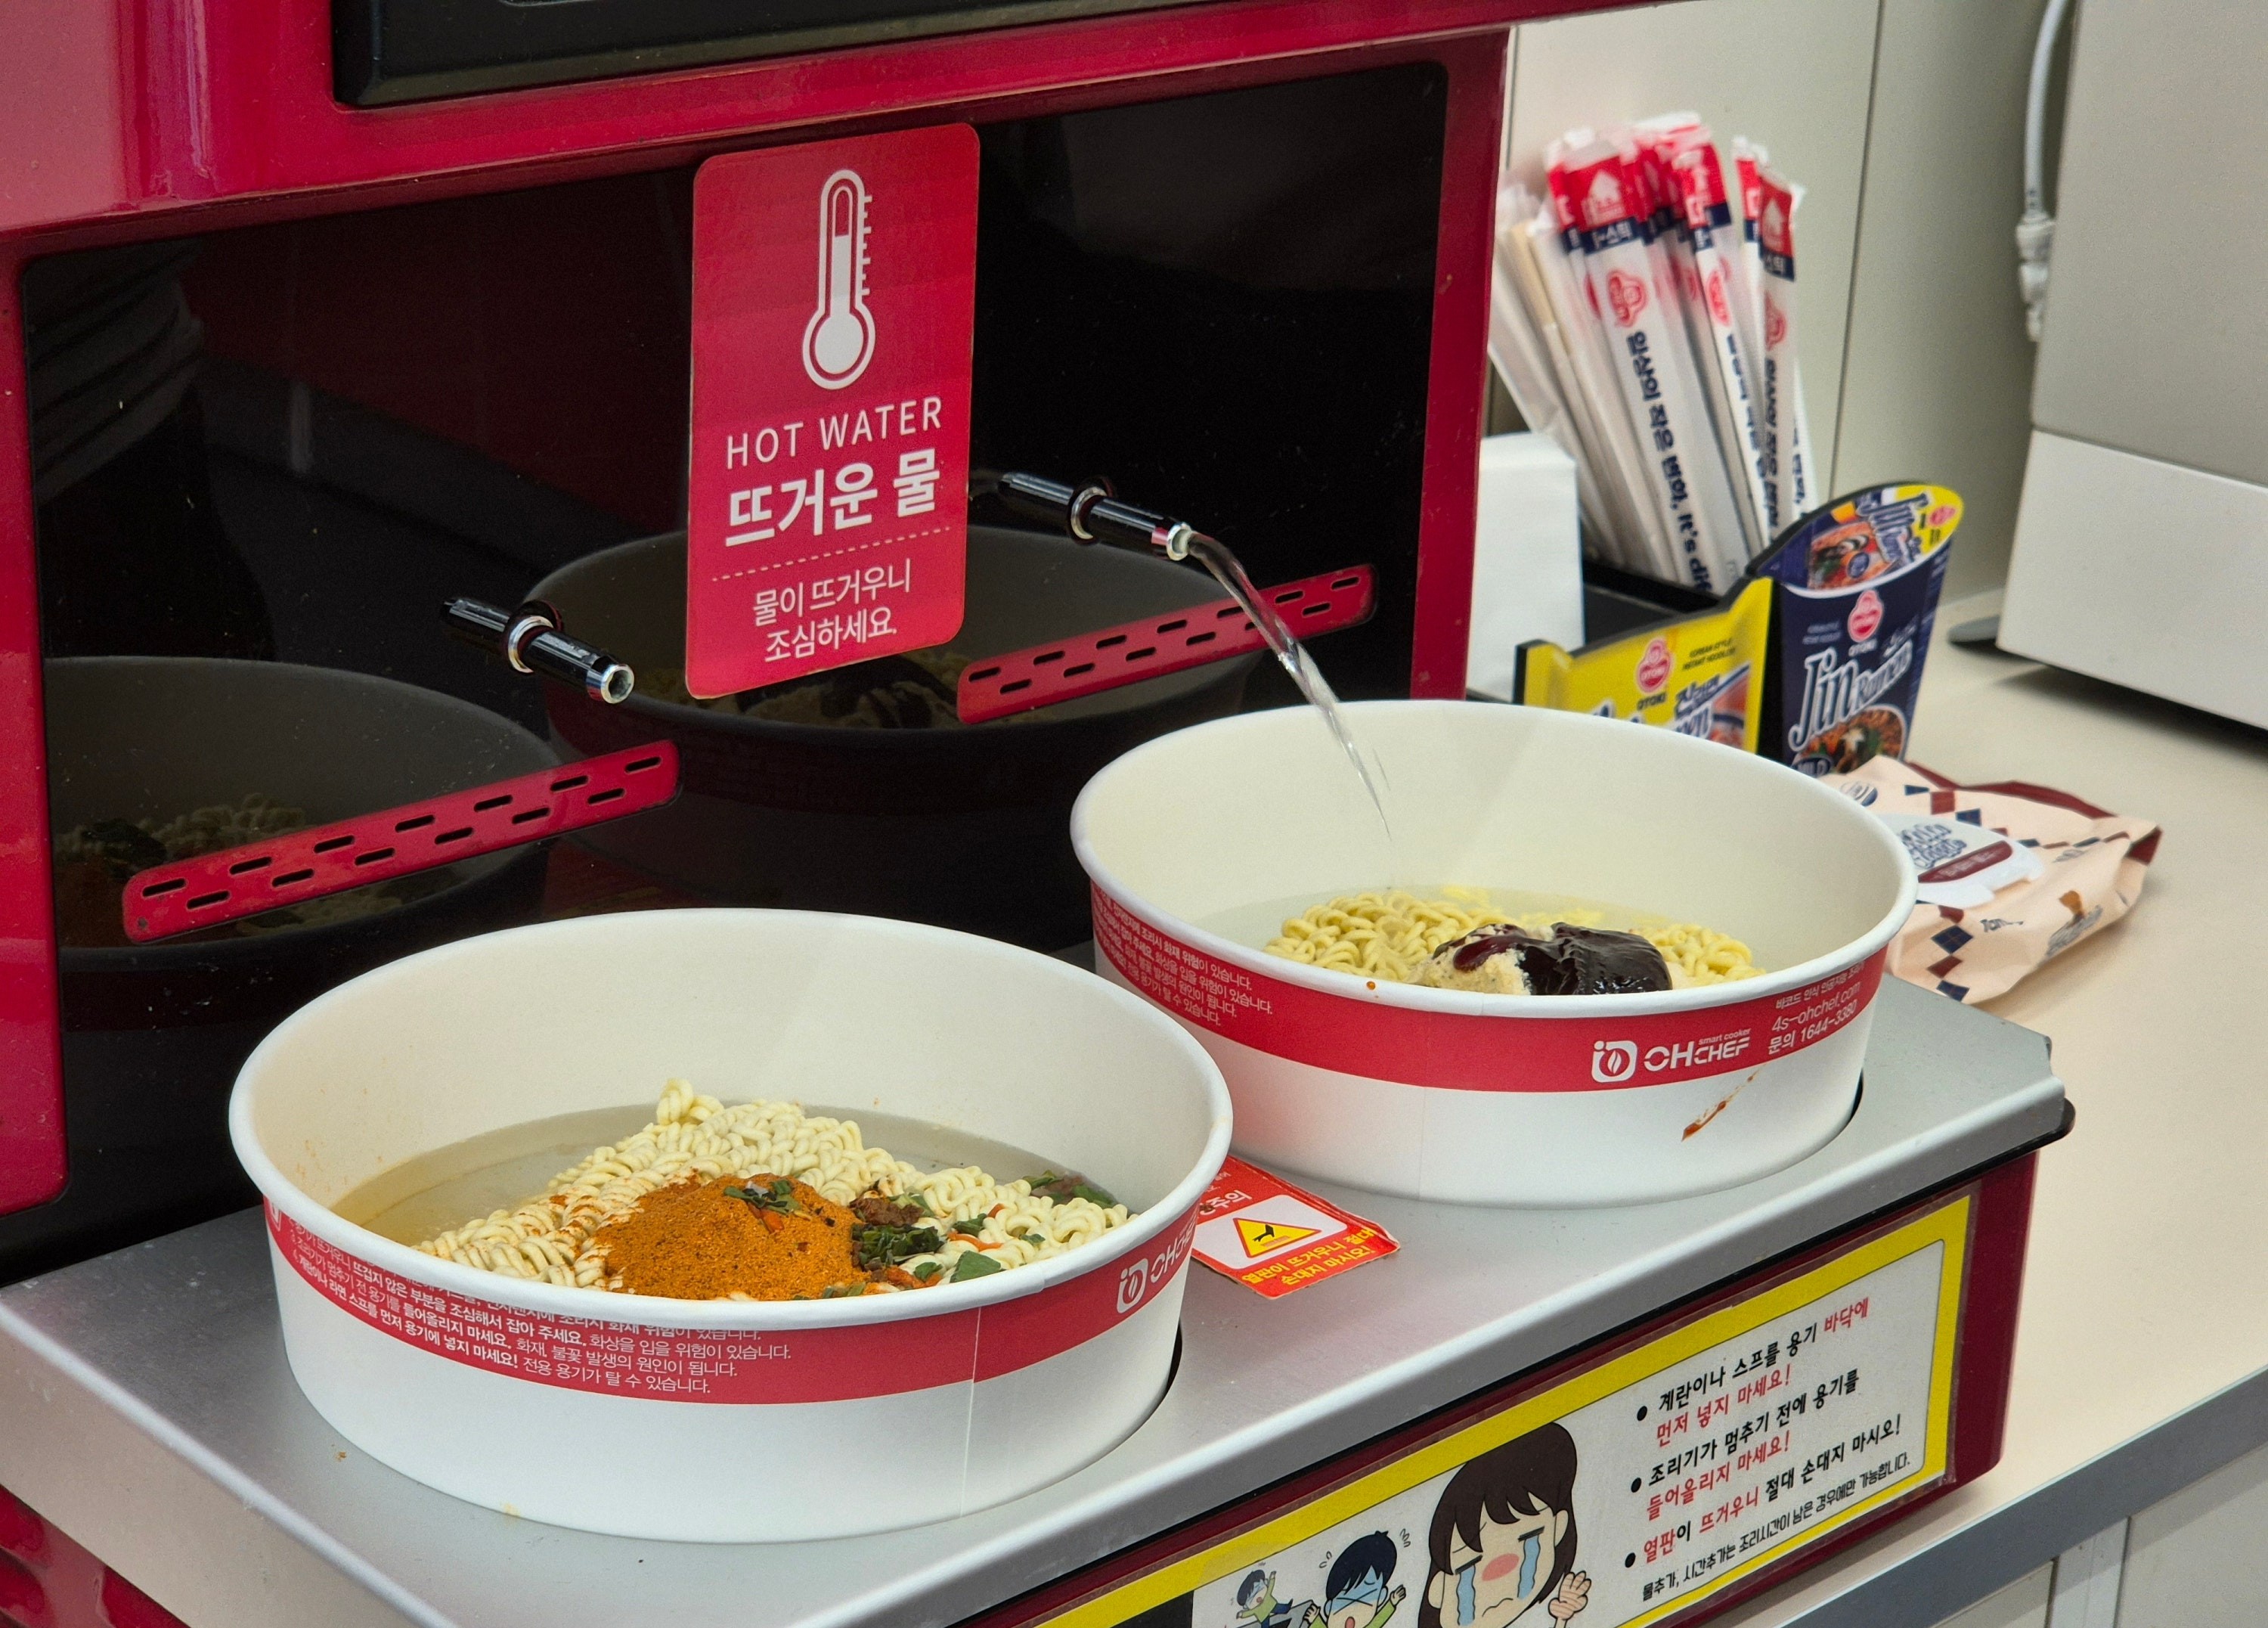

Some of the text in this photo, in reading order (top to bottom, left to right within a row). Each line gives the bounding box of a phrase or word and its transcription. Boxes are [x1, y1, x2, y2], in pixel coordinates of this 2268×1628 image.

[1627, 331, 1662, 402] 일상의
[1649, 404, 1675, 452] 작은
[727, 396, 943, 470] HOT WATER
[725, 448, 941, 547] 뜨거운 물
[752, 557, 911, 626] 물이 뜨거우니
[764, 606, 898, 663] 조심하세요.
[1637, 692, 1668, 711] OTOKI
[1788, 647, 1860, 753] Jin
[1182, 951, 1208, 974] 위험이
[1210, 963, 1252, 991] 있습니다.
[1207, 994, 1238, 1018] 됩니다.
[1229, 988, 1273, 1015] 있습니다.
[1771, 981, 1861, 1032] 4s-ohchef.com
[1775, 992, 1802, 1009] 바코드
[1803, 985, 1820, 1001] 인식
[1173, 994, 1182, 1006] 수
[1183, 998, 1222, 1026] 있습니다.
[1698, 1028, 1752, 1046] smart cooker
[1768, 1029, 1796, 1056] 문의
[1241, 1227, 1378, 1284] 열판이 뜨거우니 절대
[1280, 1264, 1328, 1286] 손대지
[329, 1279, 348, 1302] 라면
[349, 1293, 379, 1319] 스프를
[380, 1307, 403, 1332] 먼저
[405, 1320, 442, 1347] 용기에
[444, 1335, 470, 1357] 넣지
[472, 1344, 519, 1369] 마세요!
[522, 1356, 553, 1376] 전용
[555, 1362, 602, 1385] 용기가
[604, 1371, 621, 1388] 탈
[624, 1373, 643, 1389] 수
[646, 1375, 711, 1394] 있습니다.
[352, 1261, 384, 1288] 뜨겁지
[385, 1276, 409, 1298] 않은
[410, 1288, 448, 1314] 부분을
[449, 1303, 503, 1329] 조심해서
[506, 1317, 535, 1338] 잡아
[537, 1326, 587, 1347] 주세요.
[589, 1333, 636, 1353] 화상을
[639, 1339, 672, 1357] 입을
[674, 1342, 722, 1360] 위험이
[726, 1344, 792, 1360] 있습니다.
[355, 1278, 367, 1298] 전
[368, 1286, 401, 1313] 용기를
[403, 1301, 464, 1337] 들어올리지
[466, 1326, 513, 1350] 마세요.
[551, 1344, 584, 1364] 불꽃
[586, 1350, 633, 1370] 발생의
[636, 1356, 683, 1375] 원인이
[688, 1360, 738, 1378] 됩니다.
[1659, 1296, 1870, 1412] 계란이나 스프를 용기 바닥에
[1648, 1368, 1861, 1487] 조리기가 멈추기 전에 용기를
[1656, 1363, 1792, 1448] 먼저 넣지 마세요!
[1643, 1412, 1902, 1564] 열판이 뜨거우니 절대 손대지 마시오!
[1647, 1429, 1791, 1522] 들어올리지 마세요!
[1642, 1450, 1911, 1602] 물추가, 시간추가는 조리시간이 남은 경우에만 가능합니다.
